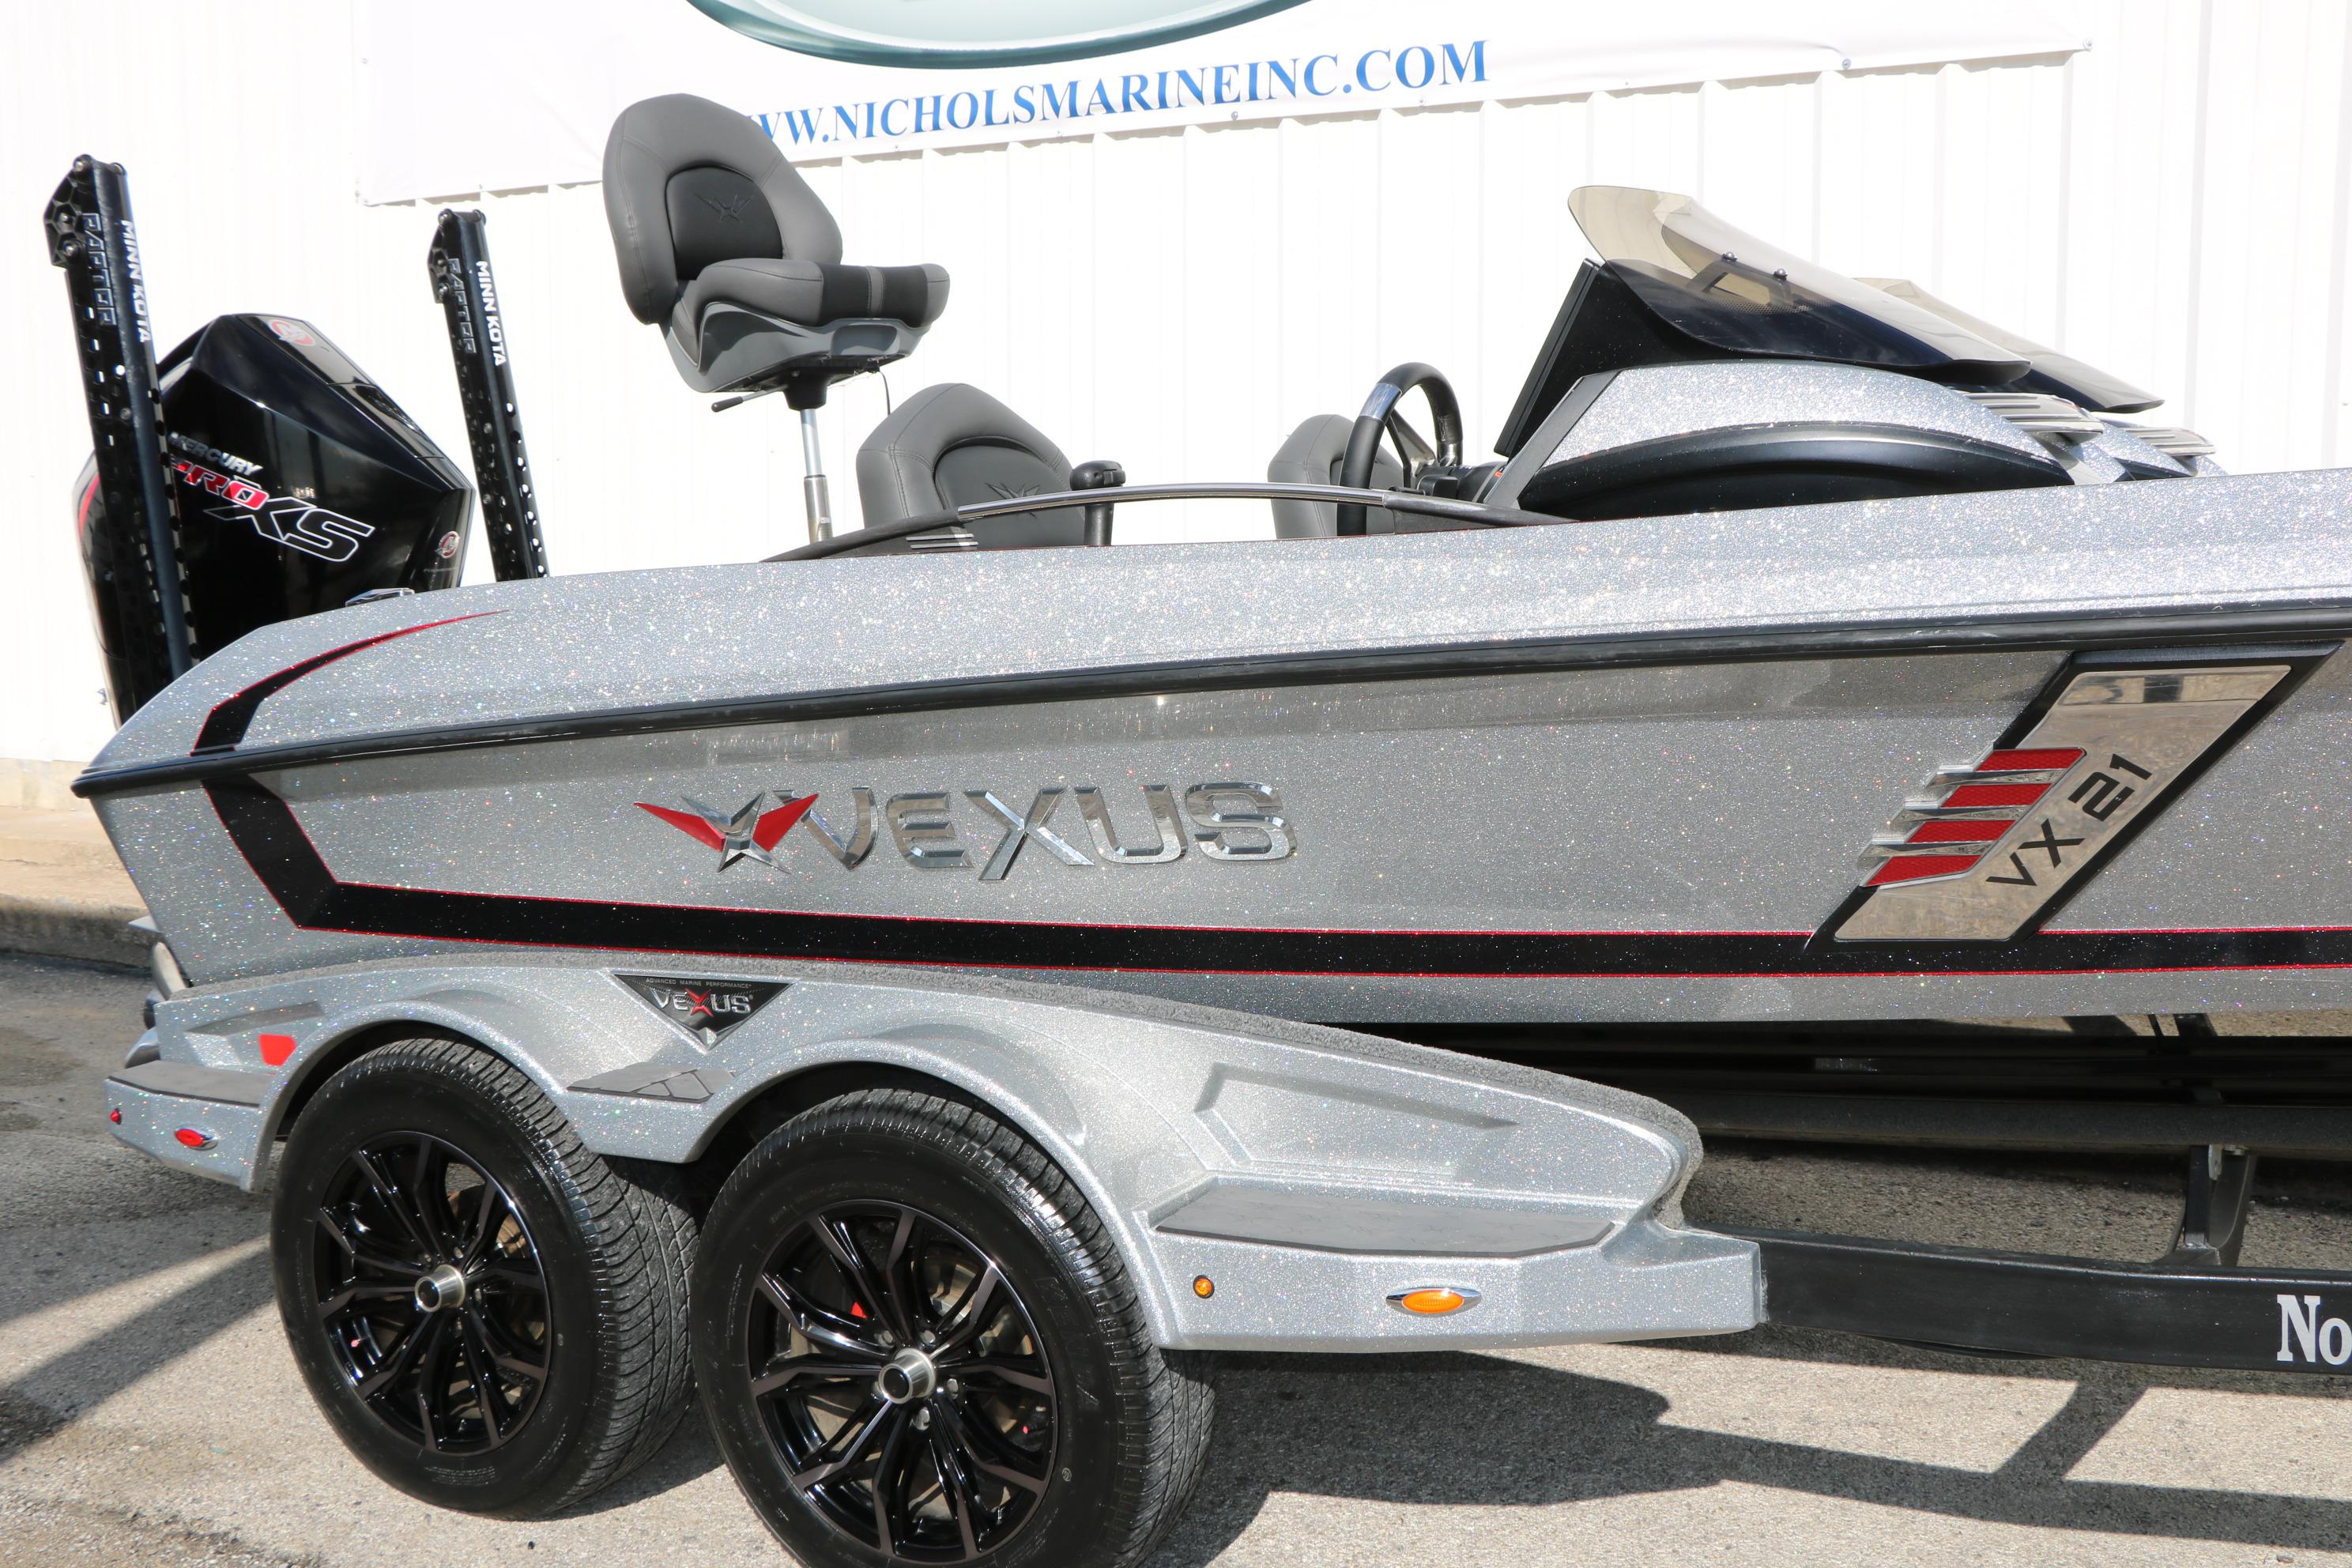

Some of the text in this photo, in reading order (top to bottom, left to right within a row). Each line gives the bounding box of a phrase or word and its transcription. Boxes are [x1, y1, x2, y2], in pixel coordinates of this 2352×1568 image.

[121, 219, 152, 343] MINN KOTA
[476, 261, 507, 366] MINN KOTA
[168, 431, 264, 476] MERCURY
[203, 474, 376, 563] XS
[773, 781, 1298, 881] VEXUS
[1985, 753, 2152, 886] VX 21
[650, 988, 752, 1018] VEXUS
[2276, 1294, 2352, 1366] No
